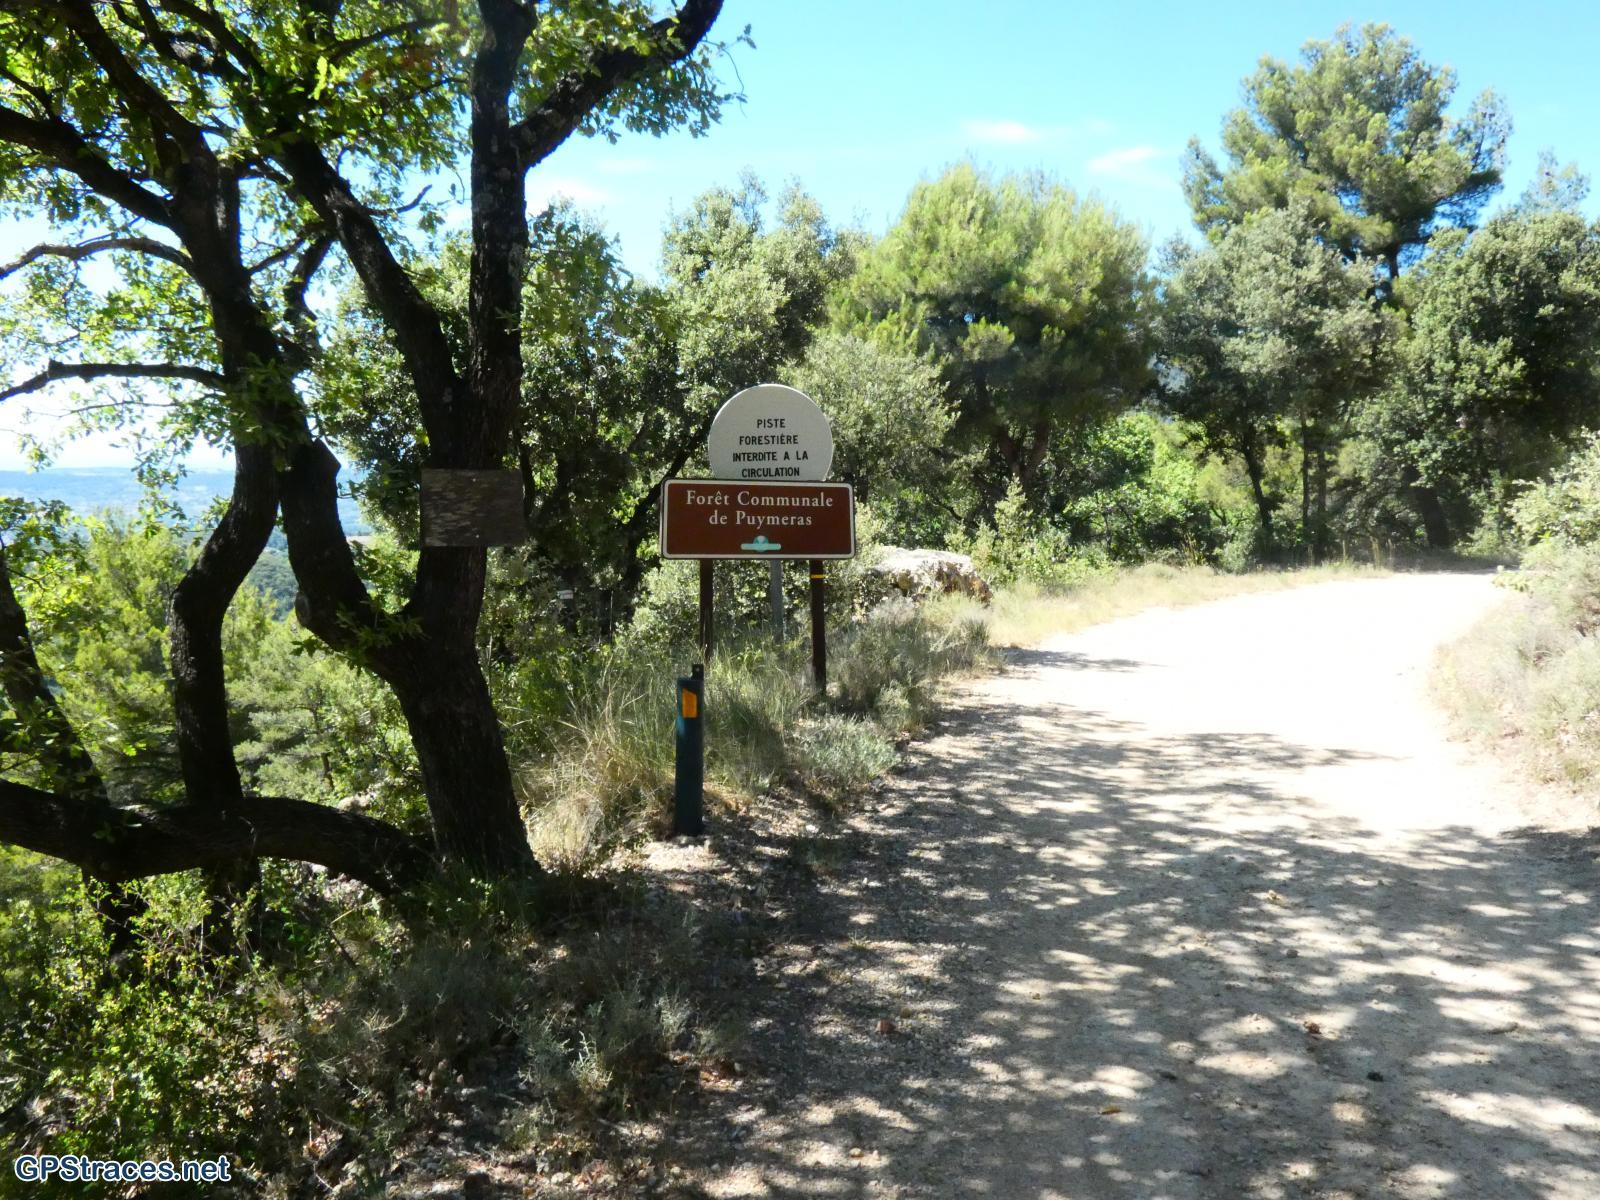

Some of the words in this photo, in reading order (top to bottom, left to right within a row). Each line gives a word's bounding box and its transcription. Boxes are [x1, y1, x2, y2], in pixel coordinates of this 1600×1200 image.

[757, 418, 786, 429] PISTE
[732, 451, 777, 462] INTERDITE
[796, 450, 809, 461] LA
[741, 467, 800, 478] CIRCULATION
[686, 490, 730, 506] Forêt
[737, 491, 833, 507] Communale
[708, 509, 728, 525] de
[735, 510, 812, 530] Puymeras
